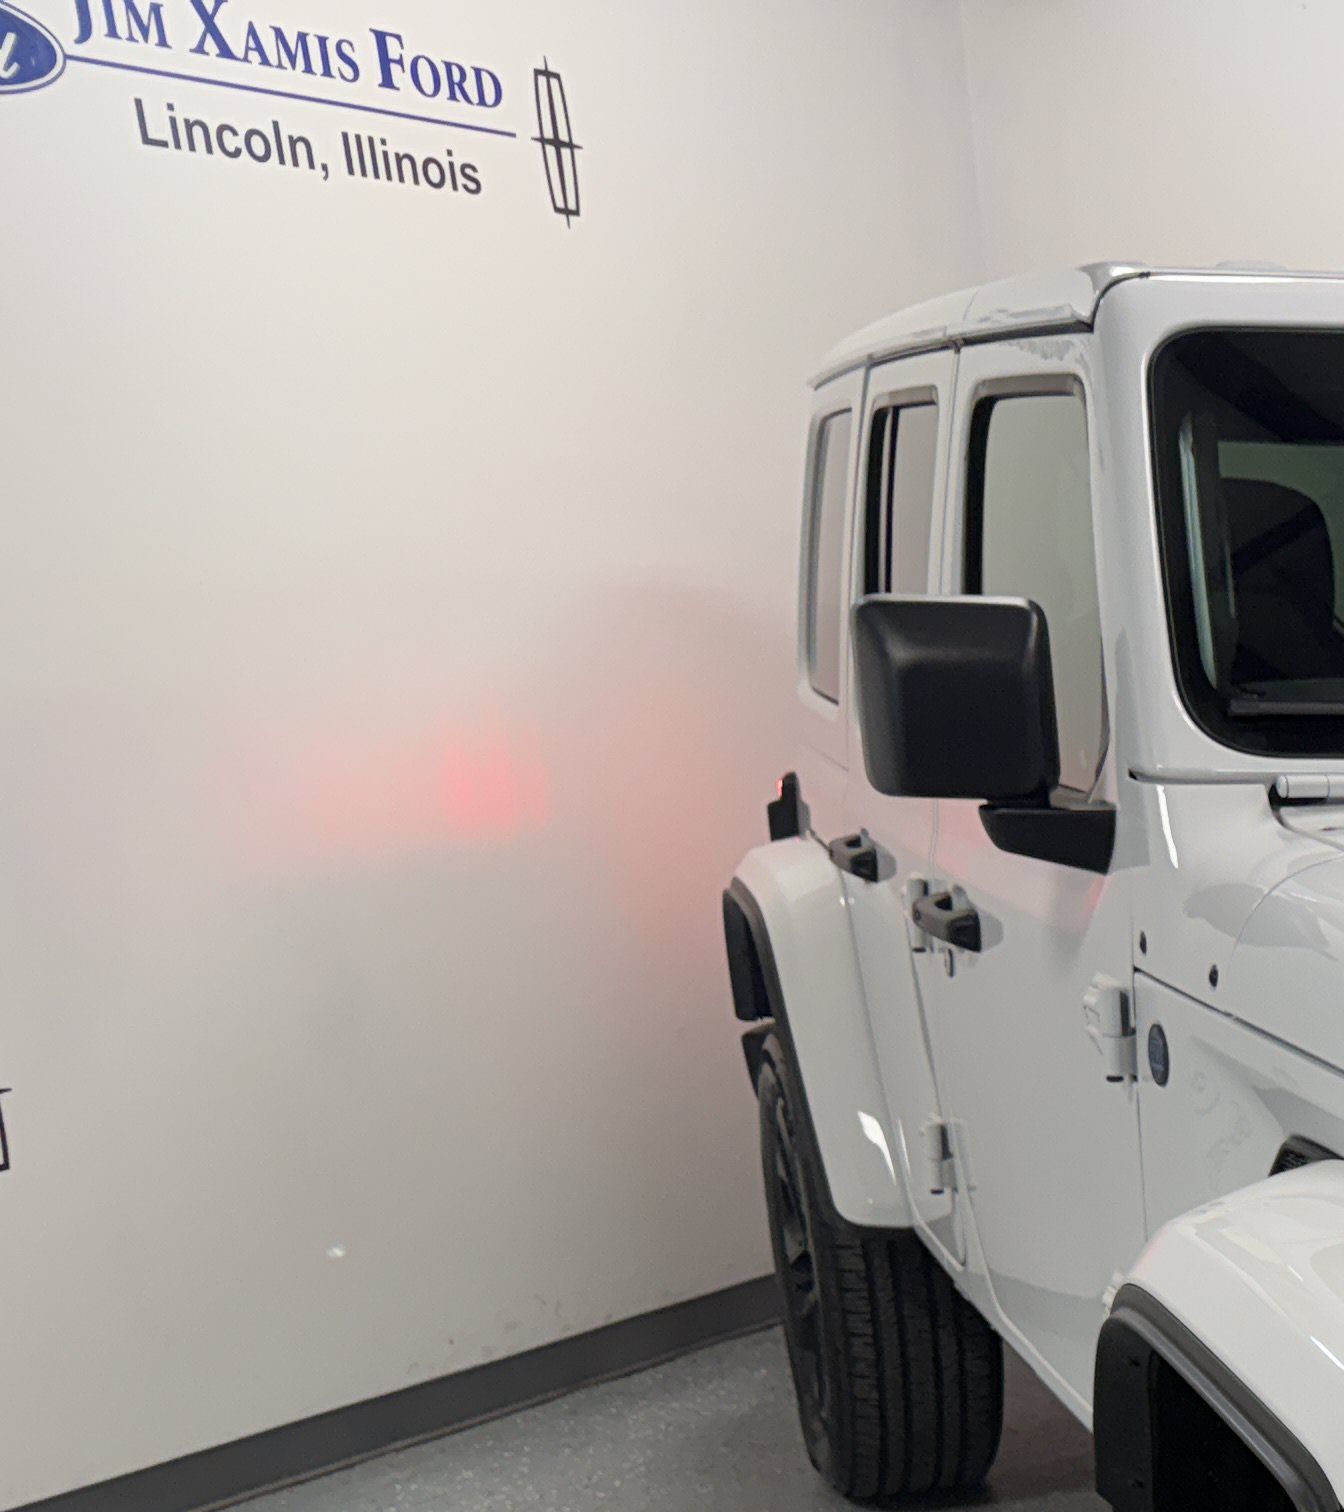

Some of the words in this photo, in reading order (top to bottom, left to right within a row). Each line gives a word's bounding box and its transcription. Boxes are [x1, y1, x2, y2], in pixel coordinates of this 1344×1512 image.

[189, 0, 360, 83] XAMIS
[369, 27, 503, 109] FORD
[134, 97, 329, 182] Lincoln,
[342, 131, 482, 195] Illinois
